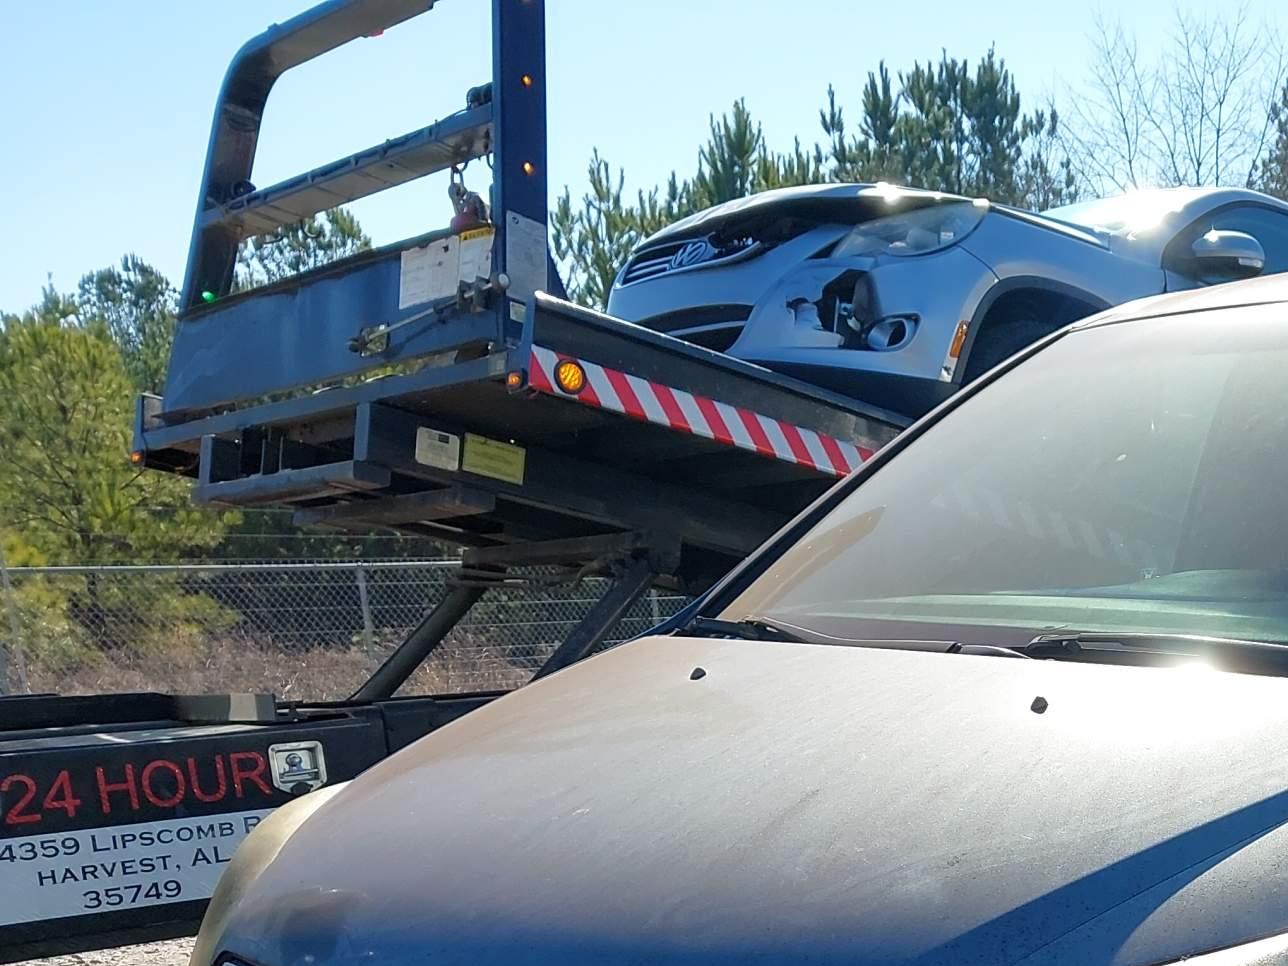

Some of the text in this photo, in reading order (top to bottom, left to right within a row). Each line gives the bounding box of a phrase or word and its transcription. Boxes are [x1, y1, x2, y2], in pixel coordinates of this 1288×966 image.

[0, 751, 273, 825] 24 HOUR
[0, 837, 80, 863] 4359
[37, 845, 232, 887] HARVEST, AL
[82, 879, 183, 910] 35749
